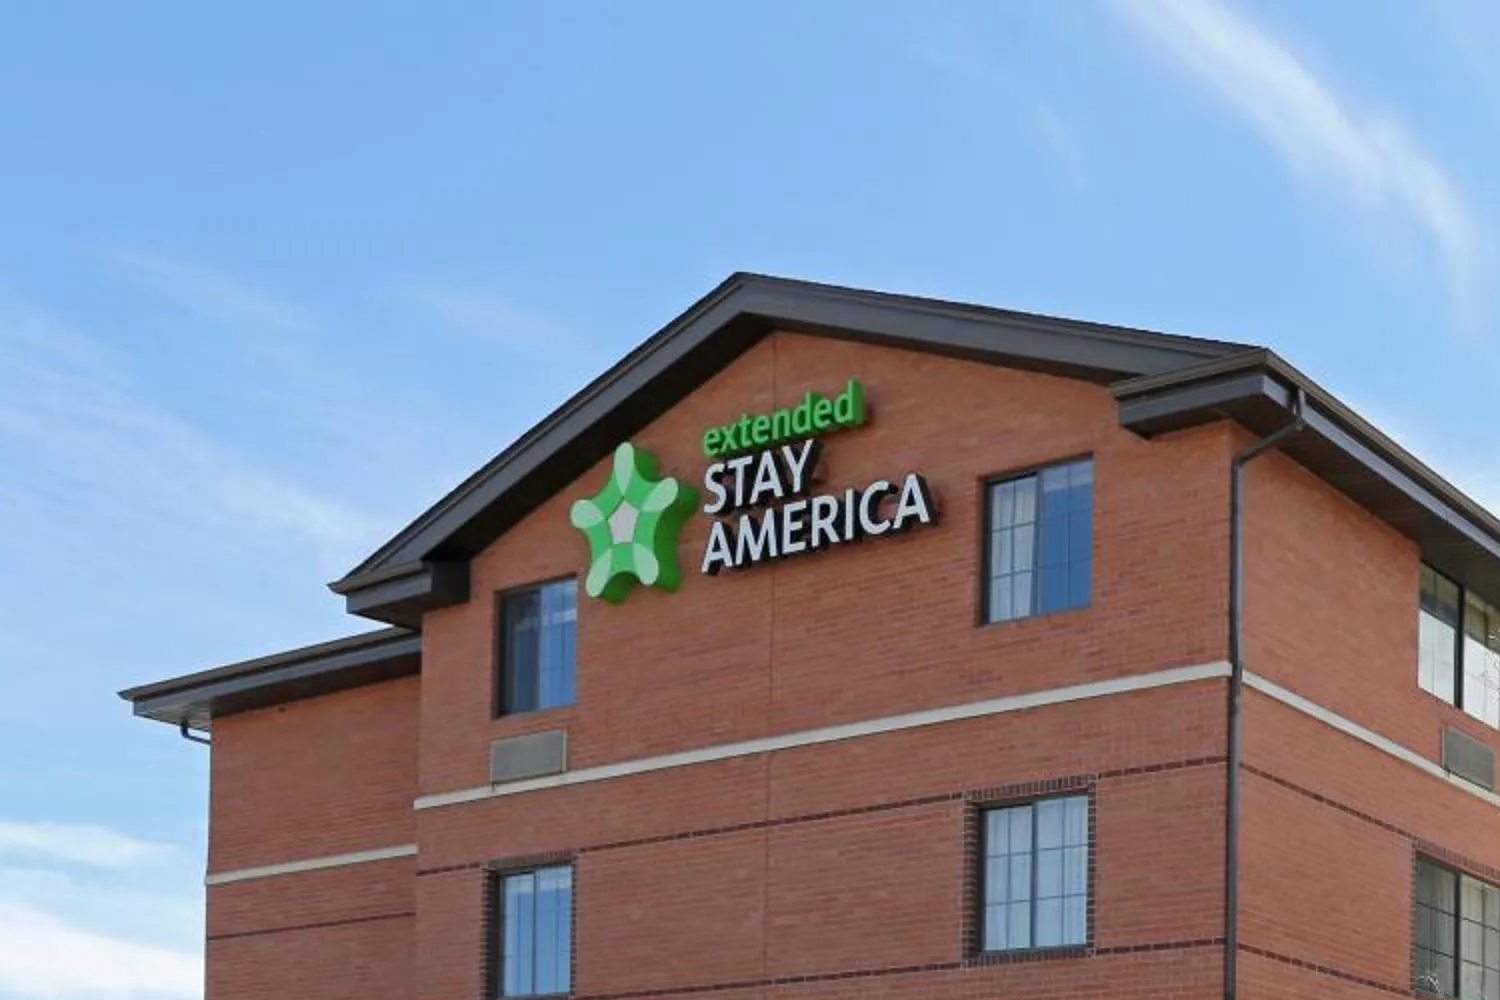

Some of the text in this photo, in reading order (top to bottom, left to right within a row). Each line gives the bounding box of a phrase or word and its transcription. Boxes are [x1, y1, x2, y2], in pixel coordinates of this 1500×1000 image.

[702, 377, 861, 457] extended
[703, 438, 815, 514] STAY
[701, 472, 931, 574] AMERICA
